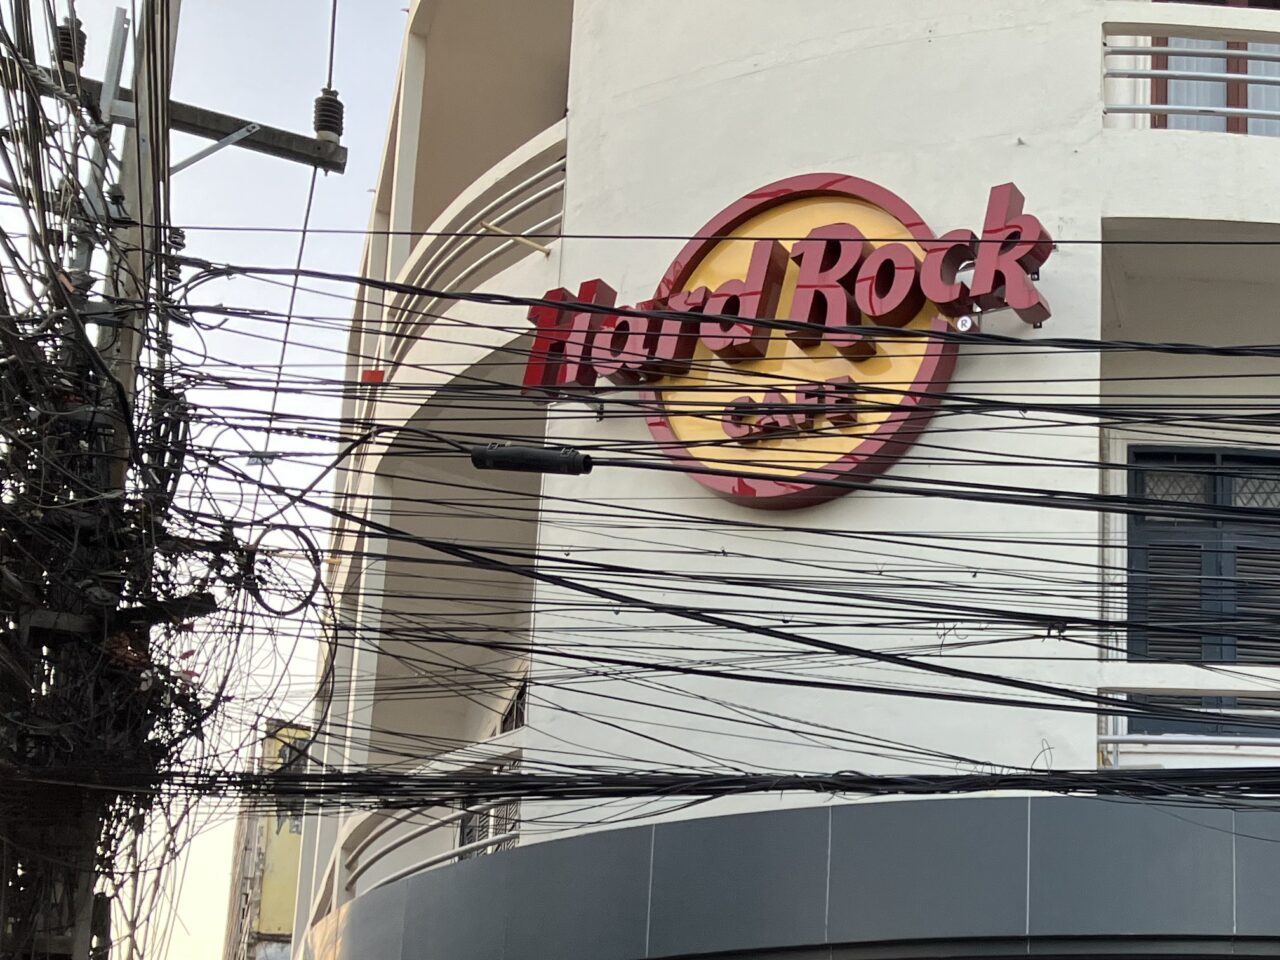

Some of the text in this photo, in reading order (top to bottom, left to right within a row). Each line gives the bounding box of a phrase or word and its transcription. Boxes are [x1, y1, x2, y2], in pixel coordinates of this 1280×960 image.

[522, 182, 1054, 400] Hard Rock
[721, 375, 857, 439] CAFE
